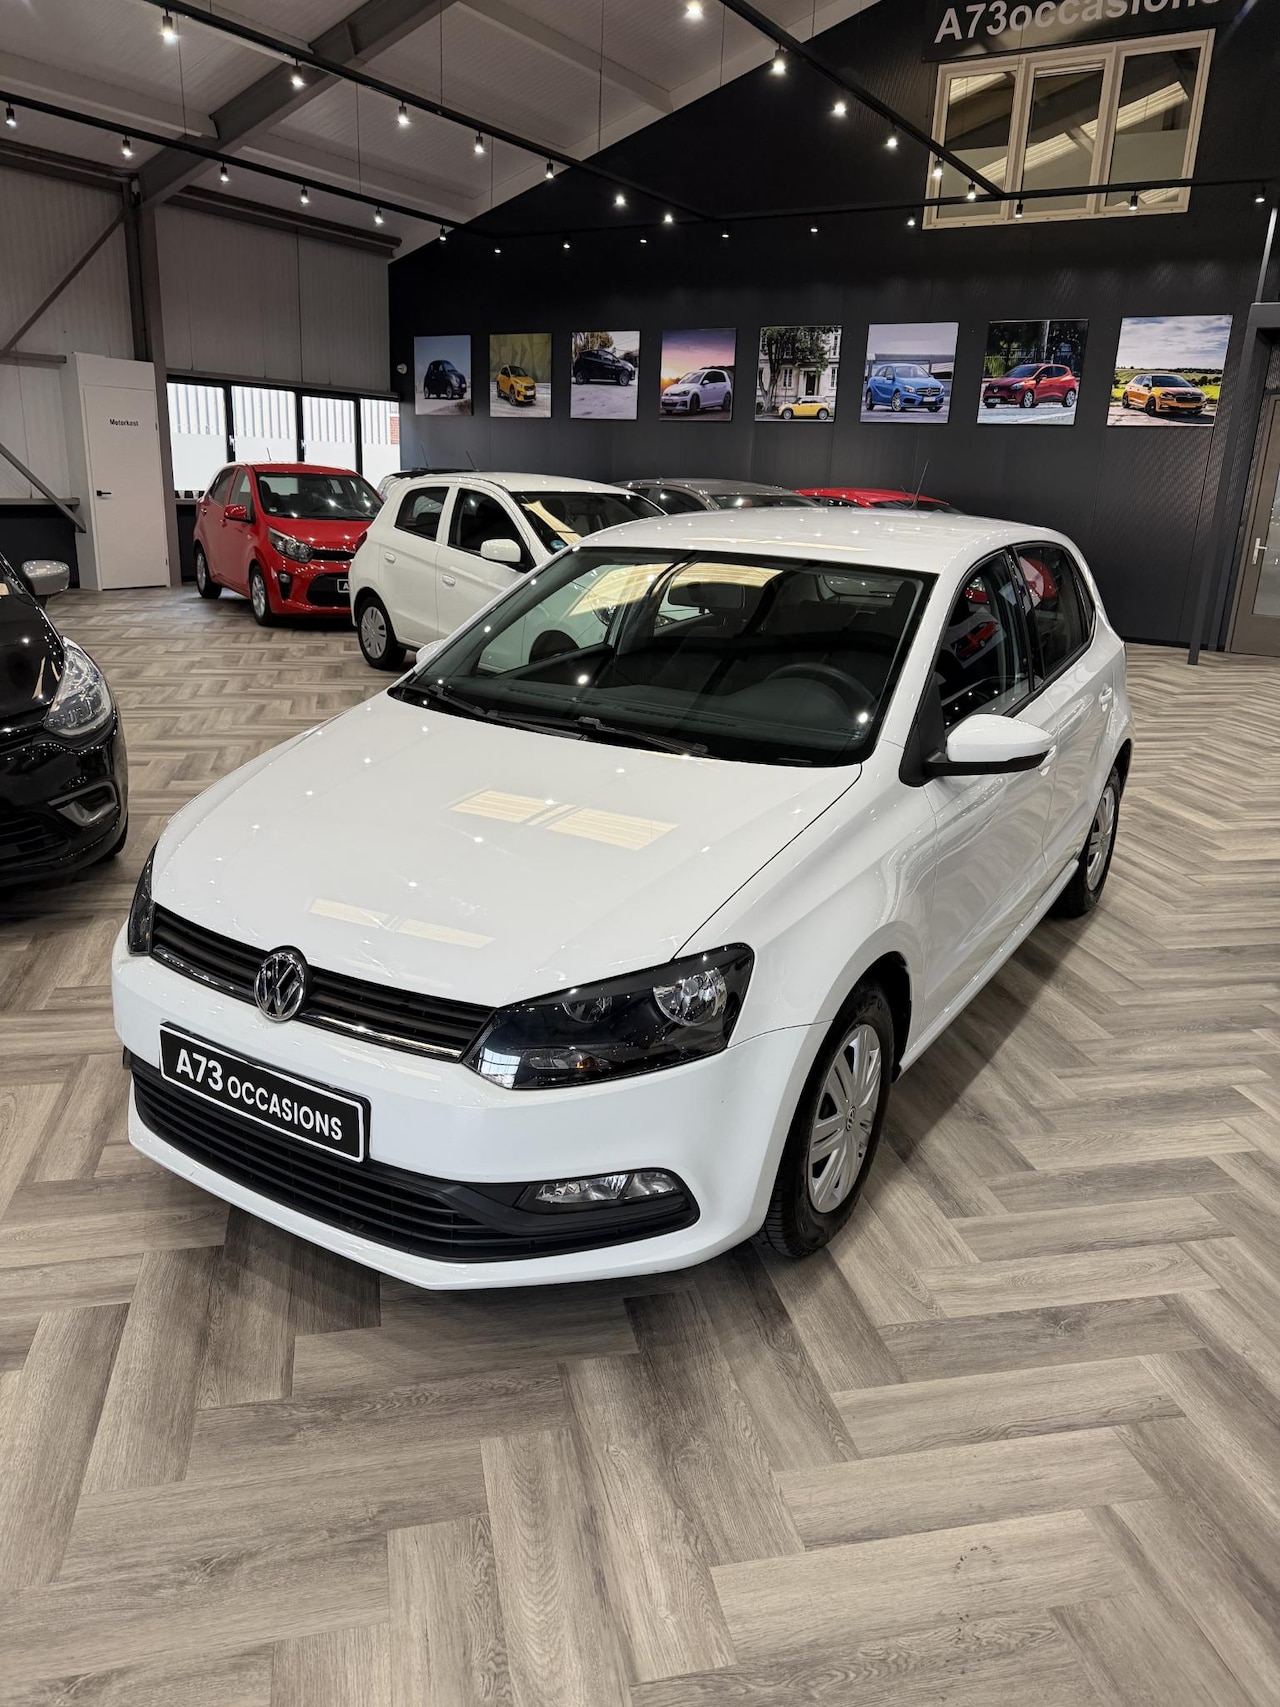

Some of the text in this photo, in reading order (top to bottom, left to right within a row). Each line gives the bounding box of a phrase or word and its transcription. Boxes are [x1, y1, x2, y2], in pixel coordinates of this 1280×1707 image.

[934, 0, 1219, 44] A73occas
[176, 1048, 342, 1141] A73 OCCASIONS
